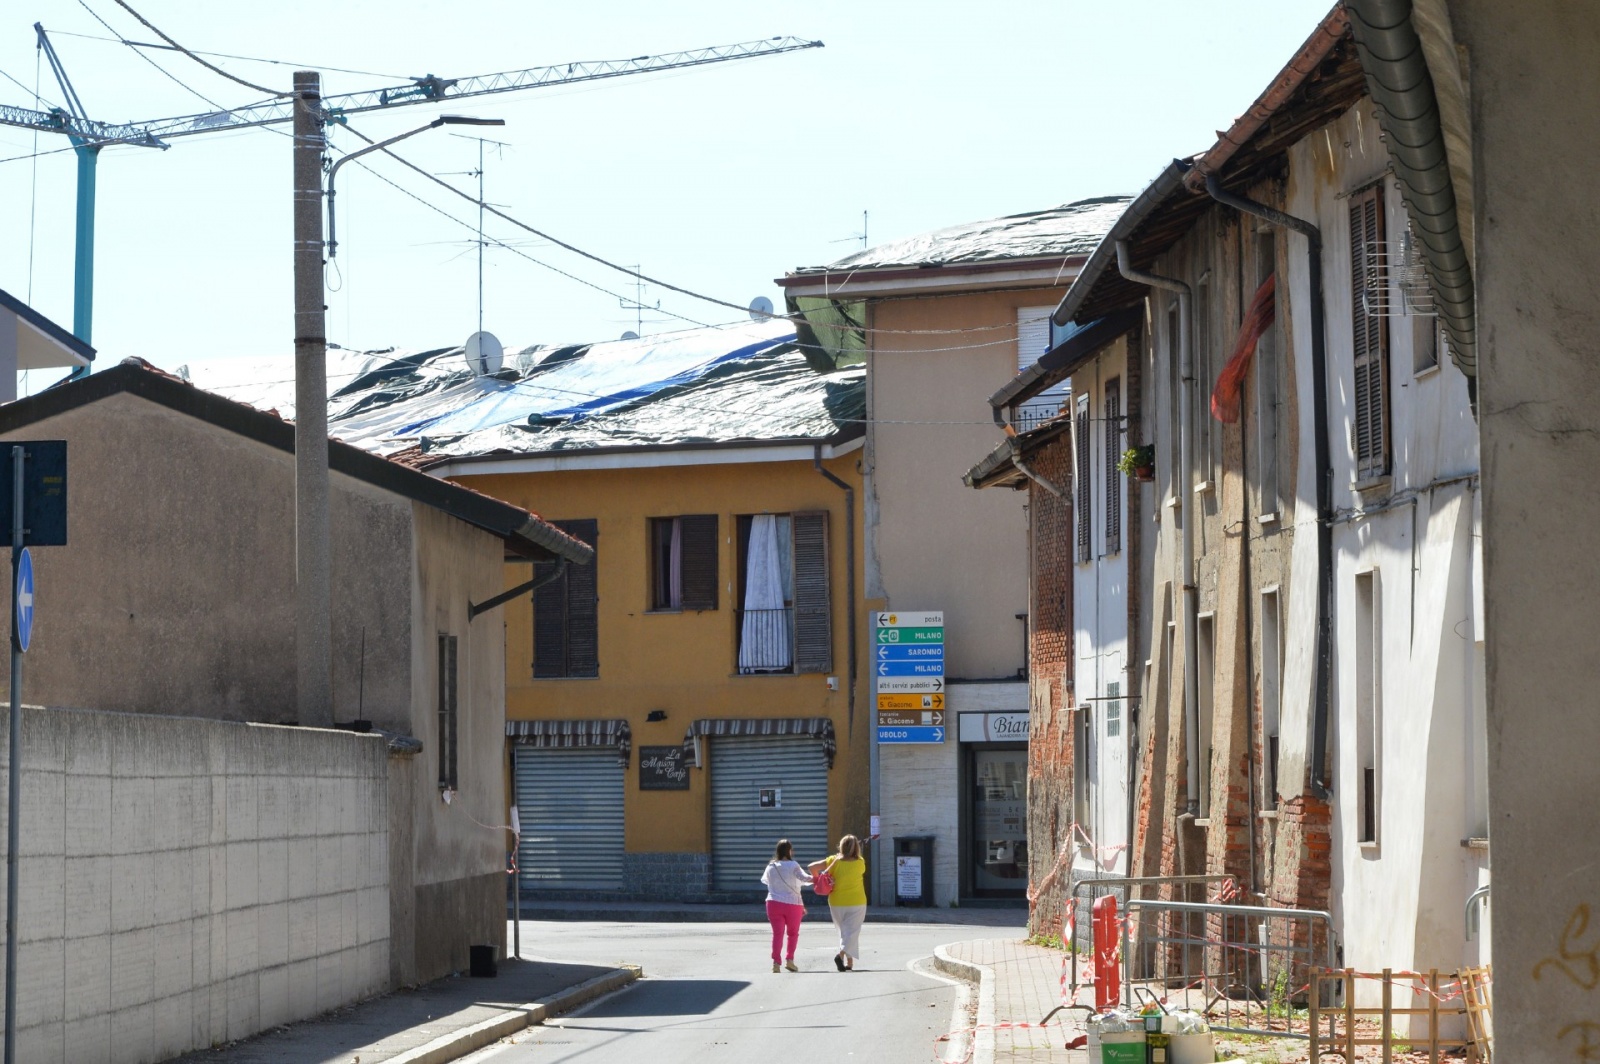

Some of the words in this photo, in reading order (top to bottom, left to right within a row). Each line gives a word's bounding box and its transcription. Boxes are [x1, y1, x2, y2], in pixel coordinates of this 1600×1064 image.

[924, 615, 942, 623] posta
[908, 648, 942, 656] SARONNO
[665, 749, 680, 760] La
[641, 756, 675, 768] Maison
